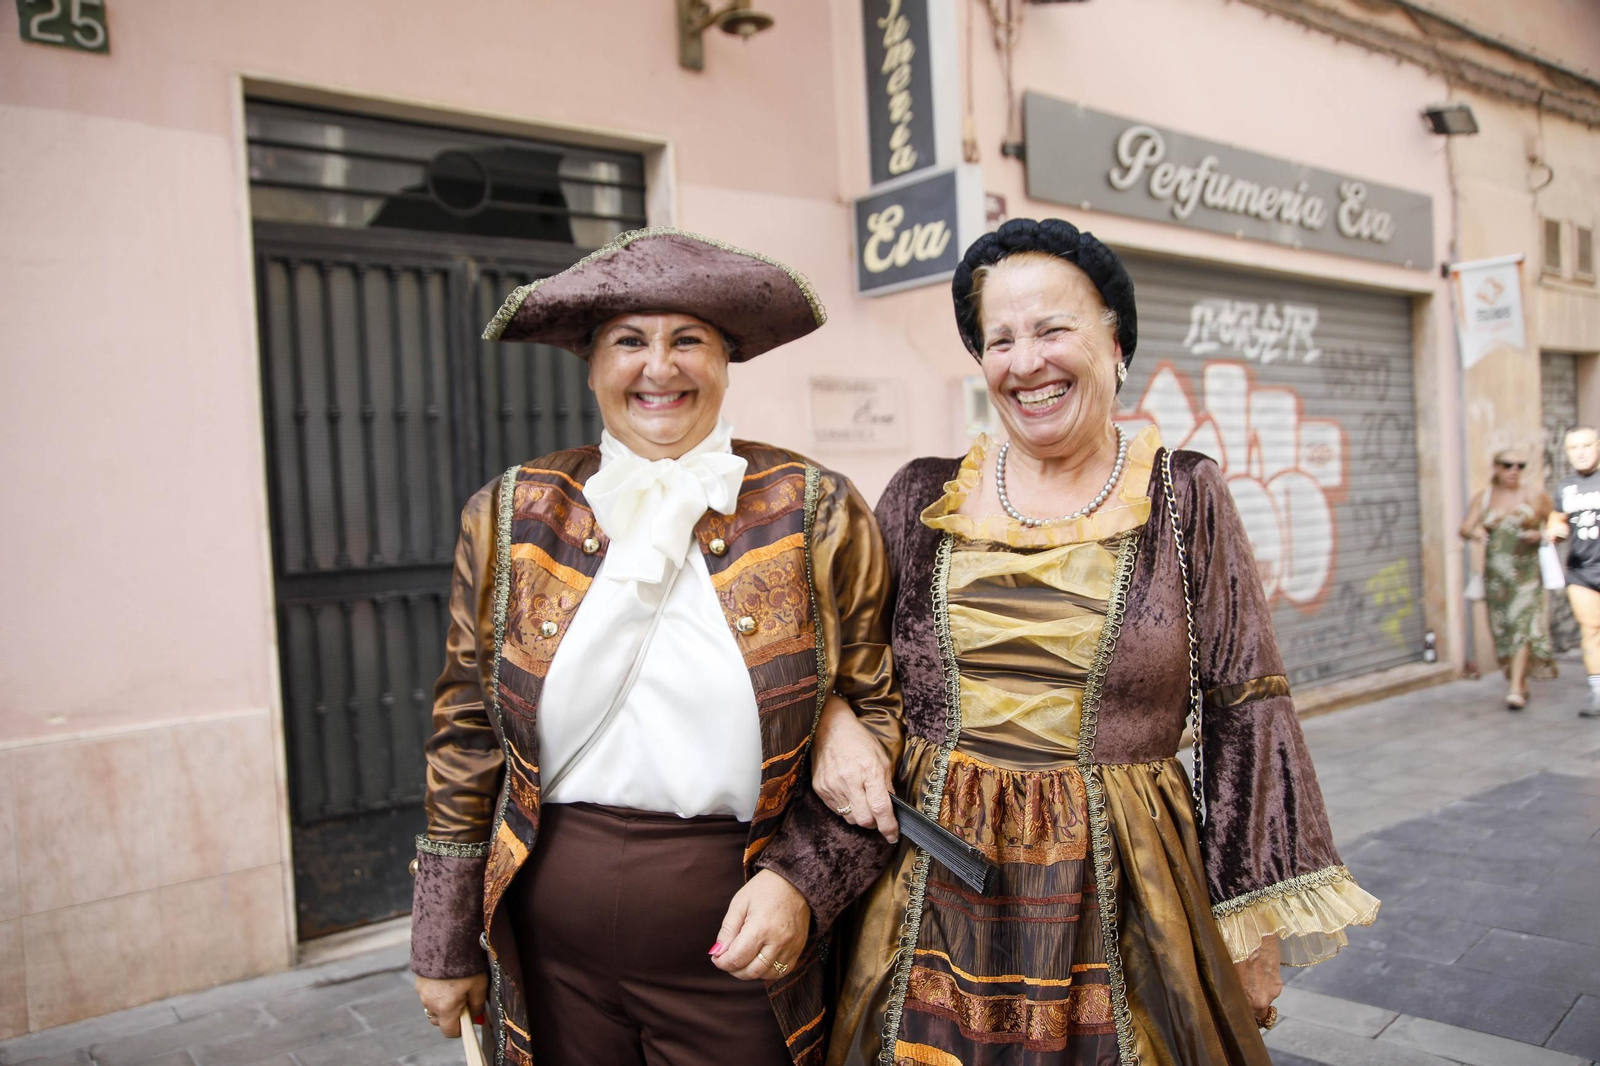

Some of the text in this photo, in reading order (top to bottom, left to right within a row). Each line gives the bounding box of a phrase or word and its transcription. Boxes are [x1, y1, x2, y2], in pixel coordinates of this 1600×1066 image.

[30, 0, 105, 48] 25
[1109, 124, 1396, 244] Perfumería Eva
[863, 204, 952, 273] Eva
